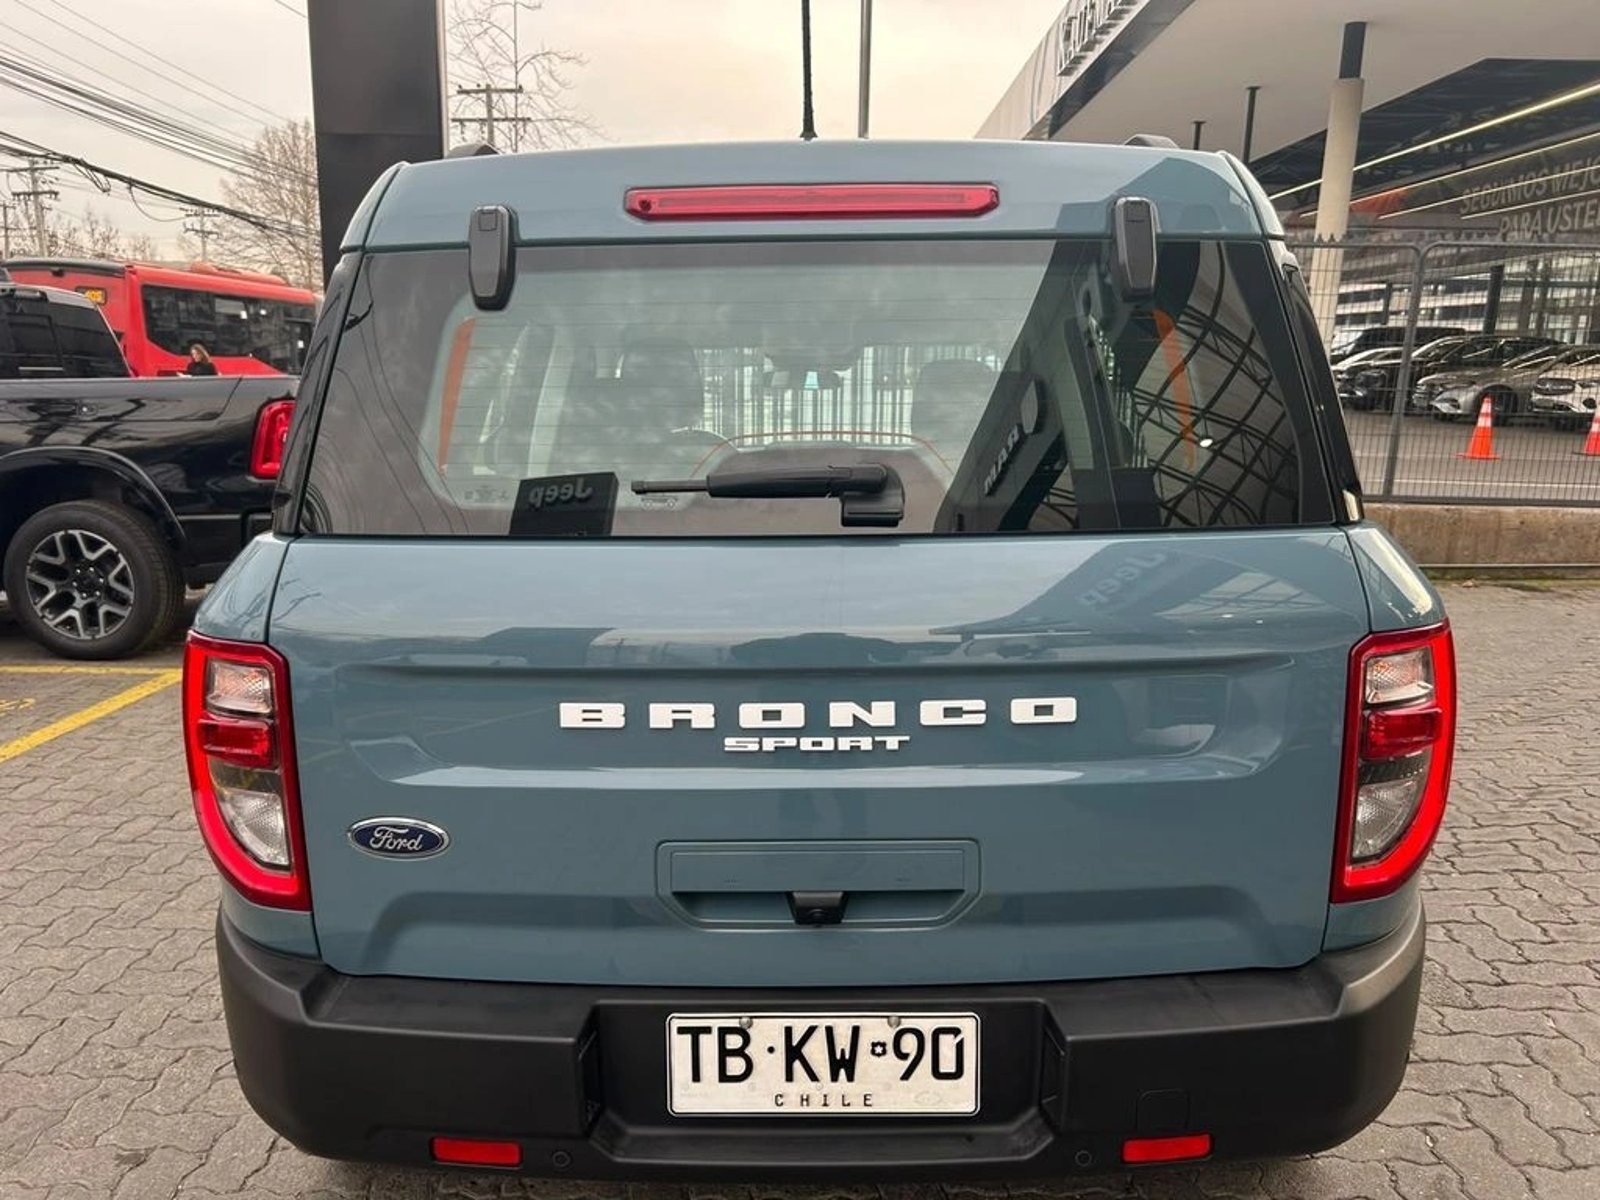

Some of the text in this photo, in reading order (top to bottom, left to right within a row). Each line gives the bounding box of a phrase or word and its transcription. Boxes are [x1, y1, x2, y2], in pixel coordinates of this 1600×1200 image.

[1499, 198, 1600, 241] PARA USTE
[559, 697, 1077, 729] BRONCO
[724, 735, 910, 751] SPORT
[369, 826, 423, 851] Ford
[774, 1093, 873, 1107] CHILE
